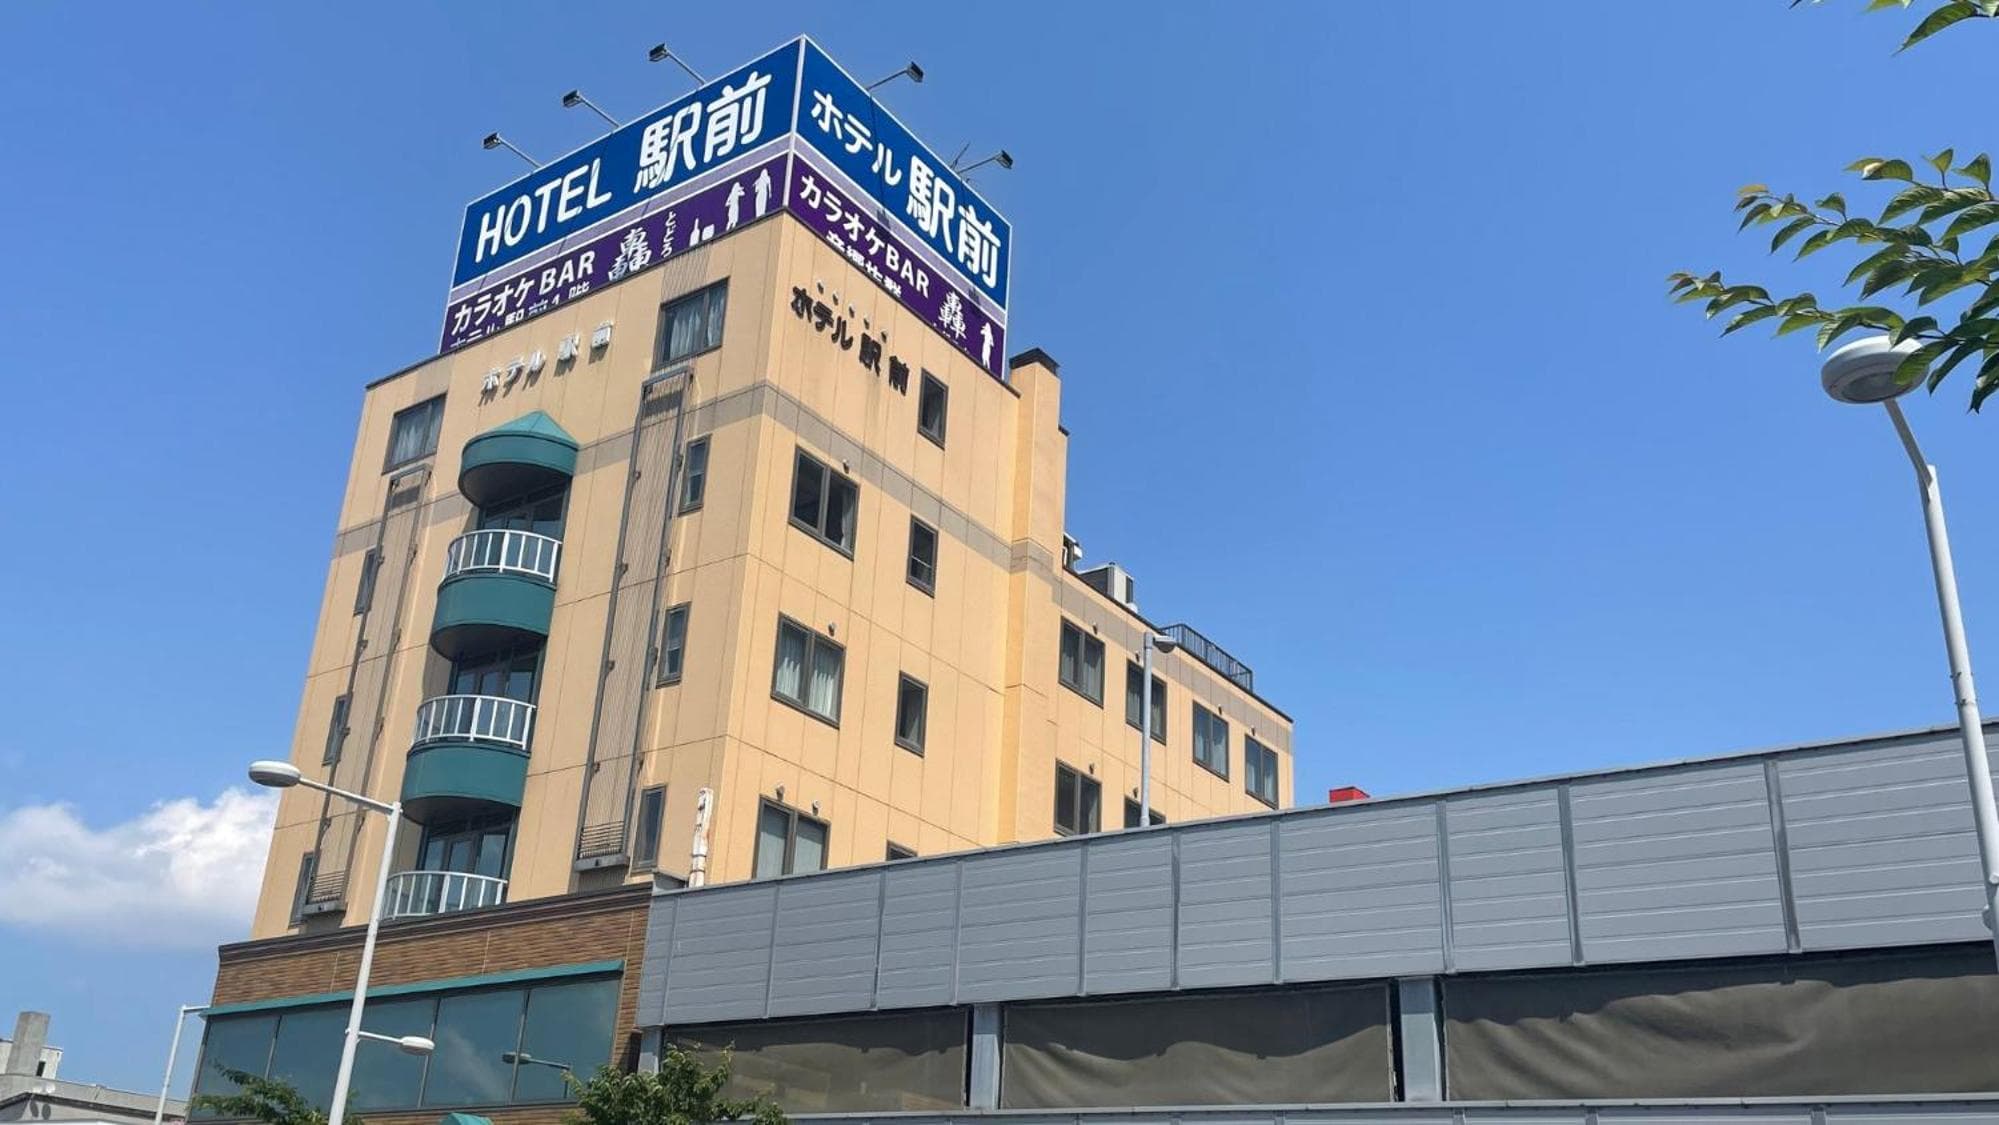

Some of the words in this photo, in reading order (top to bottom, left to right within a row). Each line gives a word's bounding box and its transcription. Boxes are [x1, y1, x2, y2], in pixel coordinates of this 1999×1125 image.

[475, 158, 612, 263] HOTEL
[633, 71, 772, 193] 駅前
[811, 89, 902, 186] ホテル
[906, 155, 1001, 289] 駅前
[791, 286, 854, 350] ホテル
